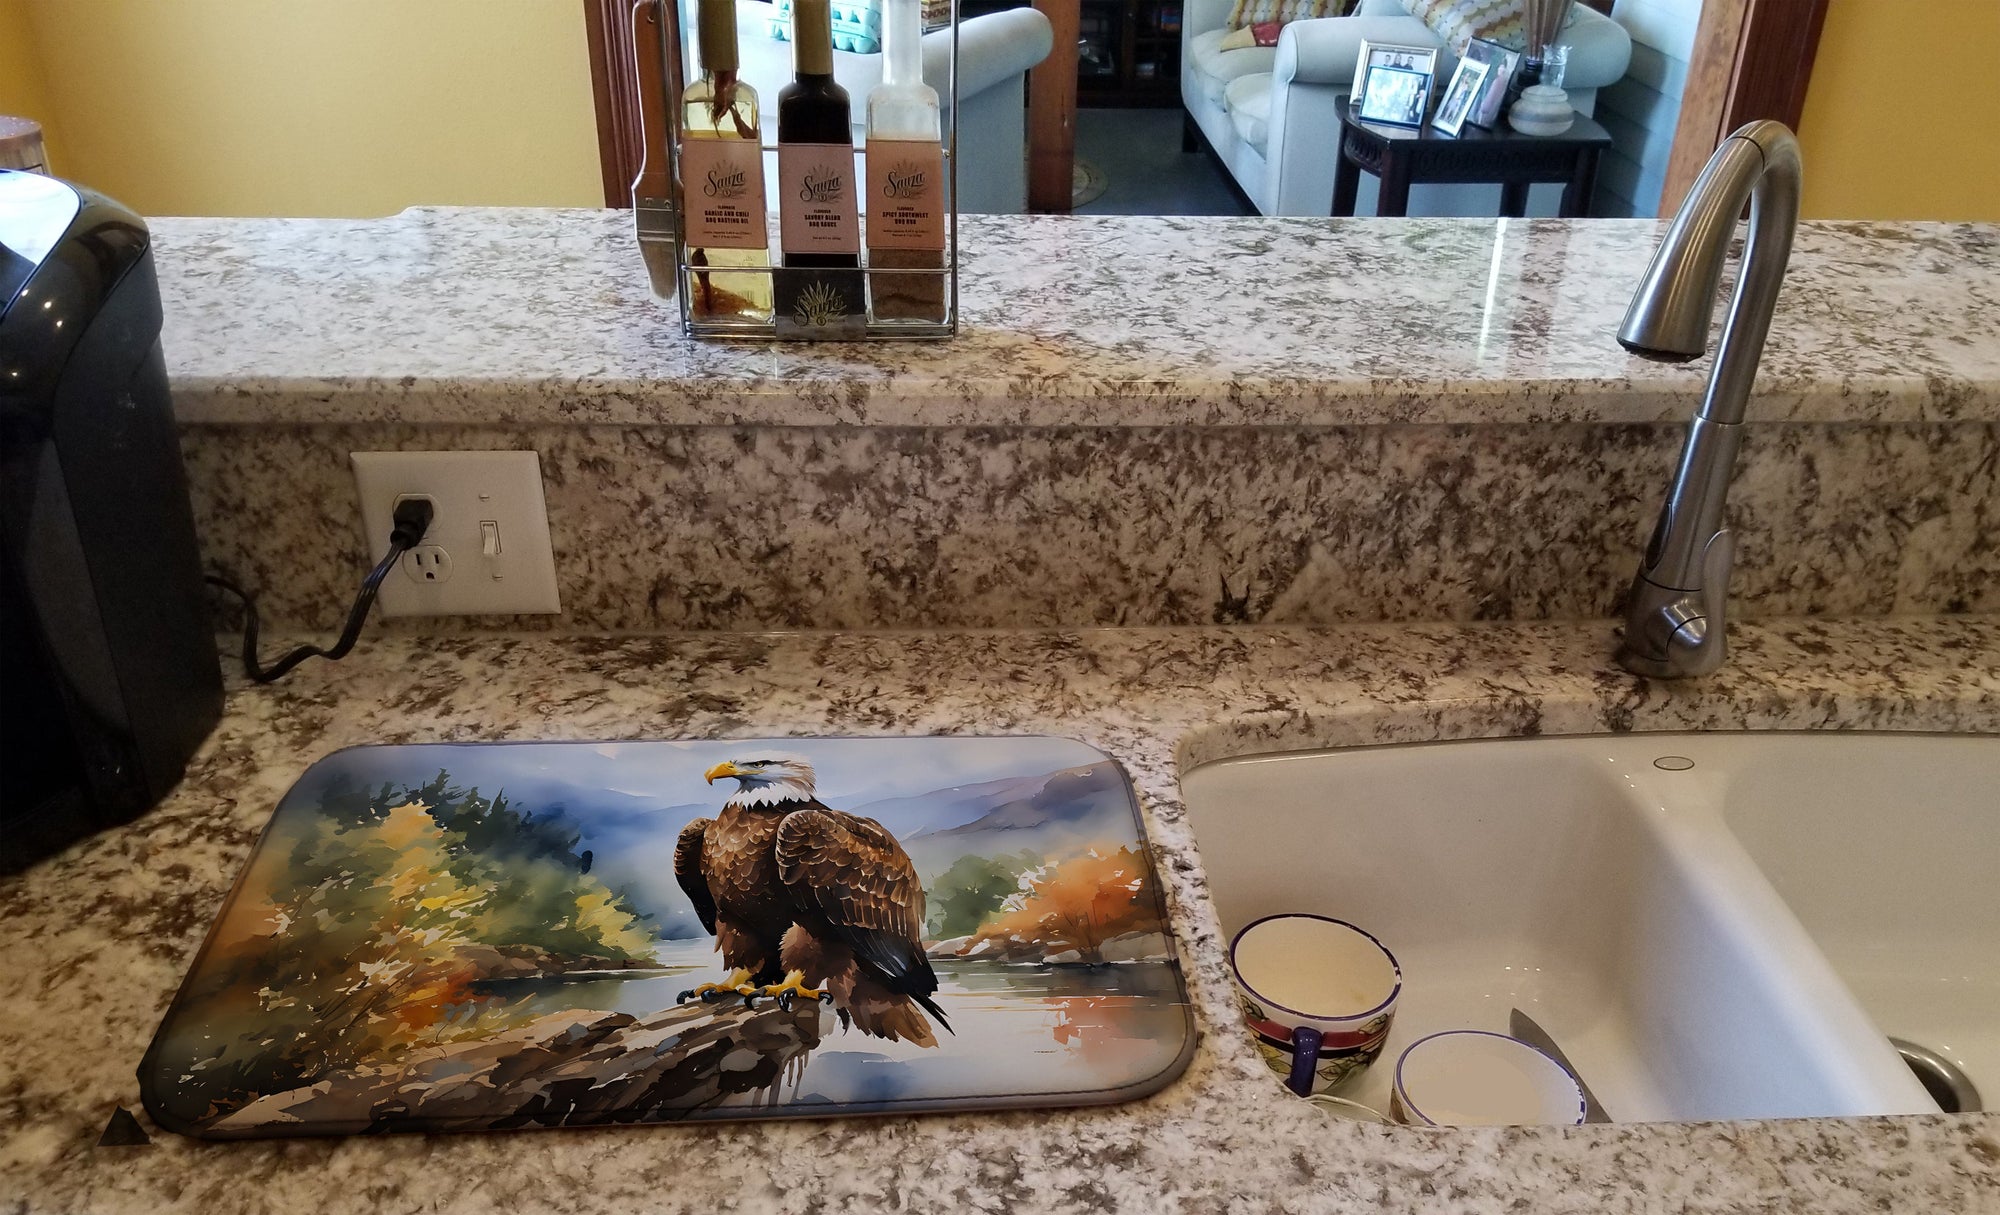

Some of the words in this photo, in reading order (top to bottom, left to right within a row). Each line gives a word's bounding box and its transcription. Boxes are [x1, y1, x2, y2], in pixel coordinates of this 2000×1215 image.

[704, 170, 745, 197] Sauza
[800, 175, 841, 202] Sauza
[883, 171, 924, 198] Sauza
[793, 296, 843, 326] Sauza
